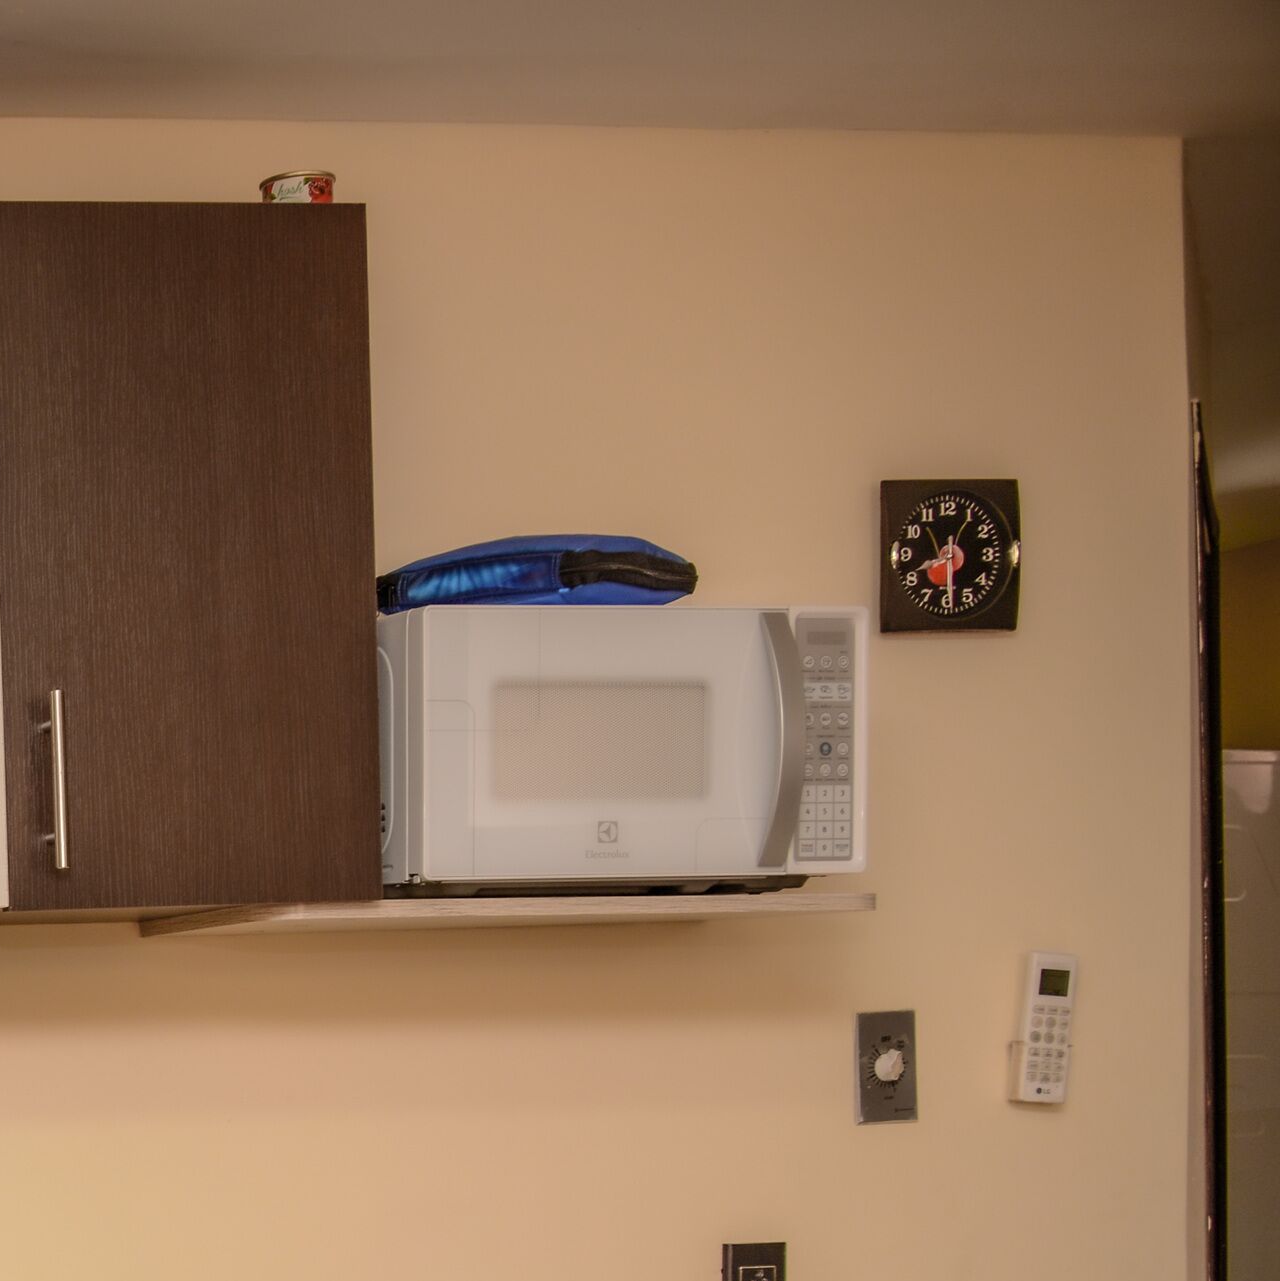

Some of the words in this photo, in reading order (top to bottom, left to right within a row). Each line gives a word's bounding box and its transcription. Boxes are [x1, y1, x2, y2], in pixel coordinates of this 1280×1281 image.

[921, 508, 935, 522] 11
[939, 502, 957, 516] 12
[966, 508, 973, 521] 1
[907, 525, 920, 539] 10
[978, 525, 989, 538] 2
[900, 548, 912, 561] 9
[982, 548, 994, 561] 3
[906, 571, 918, 586] 8
[975, 572, 988, 585] 4
[921, 588, 933, 602] 7
[941, 594, 952, 608] 6
[962, 588, 974, 602] 5
[584, 848, 630, 859] Electrolux
